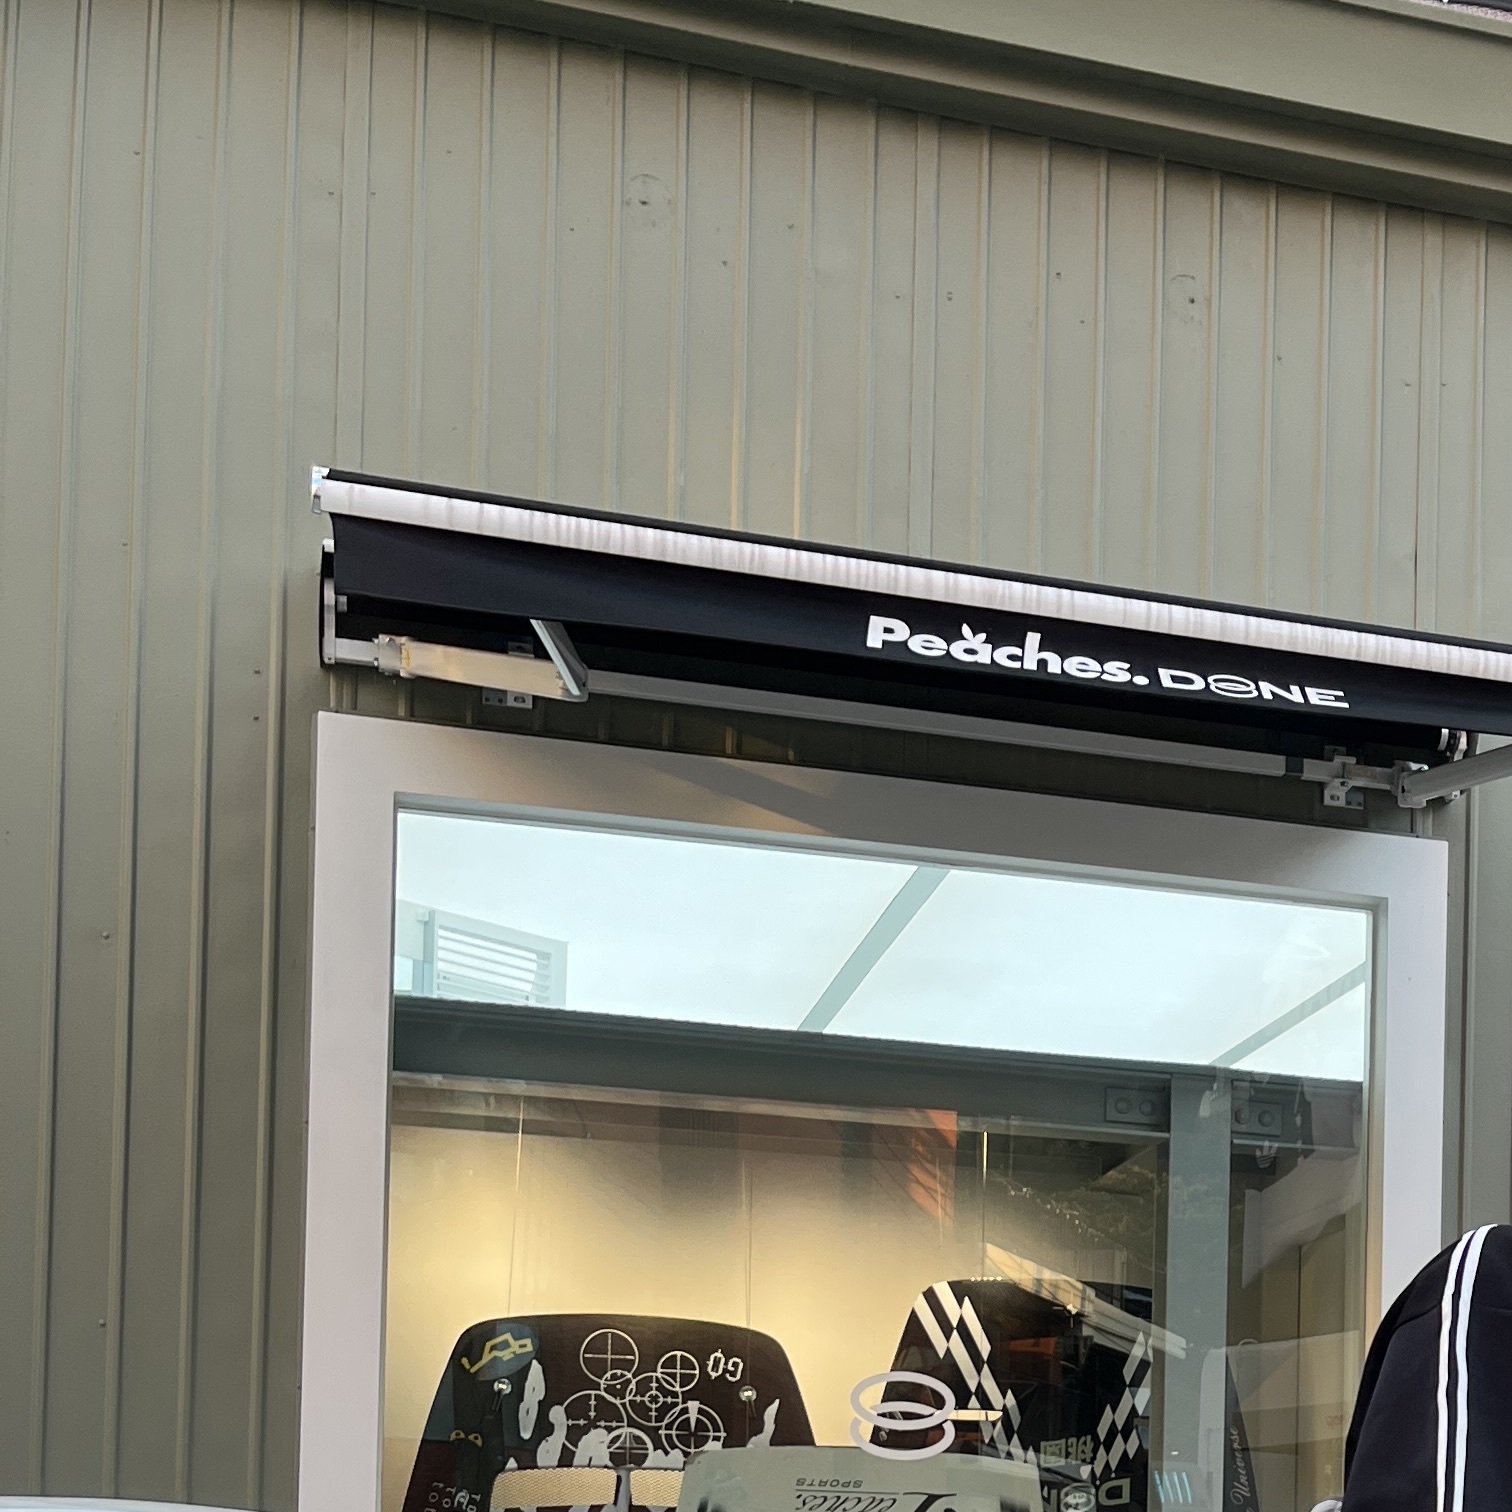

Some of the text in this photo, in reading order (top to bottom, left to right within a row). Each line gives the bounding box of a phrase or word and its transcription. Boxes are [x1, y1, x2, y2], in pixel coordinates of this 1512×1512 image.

[866, 615, 1349, 708] Peaches. DONE
[796, 1477, 863, 1488] SPORTS
